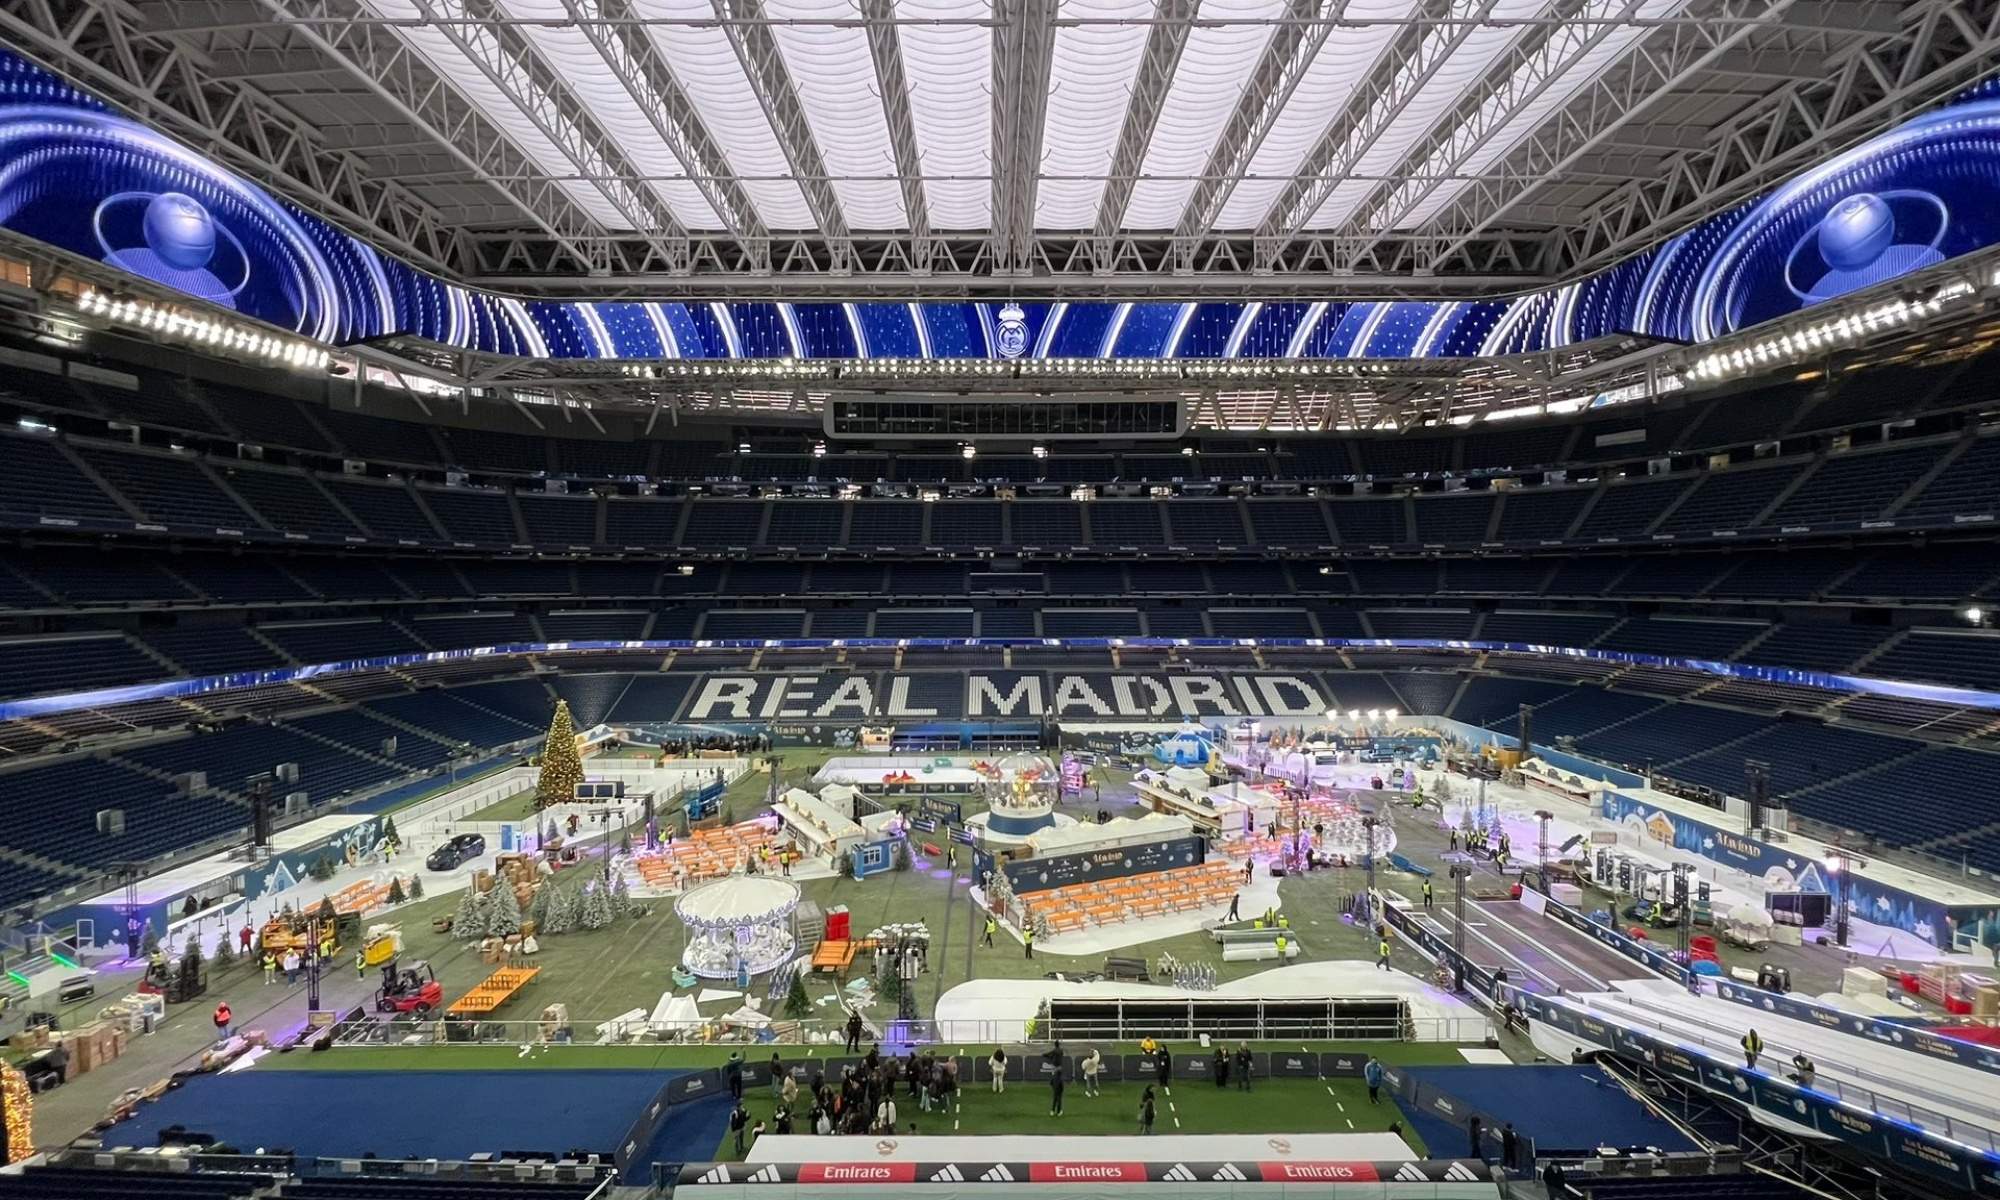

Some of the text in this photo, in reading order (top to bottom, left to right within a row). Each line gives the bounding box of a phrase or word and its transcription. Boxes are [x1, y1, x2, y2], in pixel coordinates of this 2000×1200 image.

[688, 675, 1328, 718] REAL MADRID
[823, 1165, 891, 1180] Emirates
[1055, 1165, 1123, 1180] Emirates
[1284, 1164, 1353, 1179] Emirates
